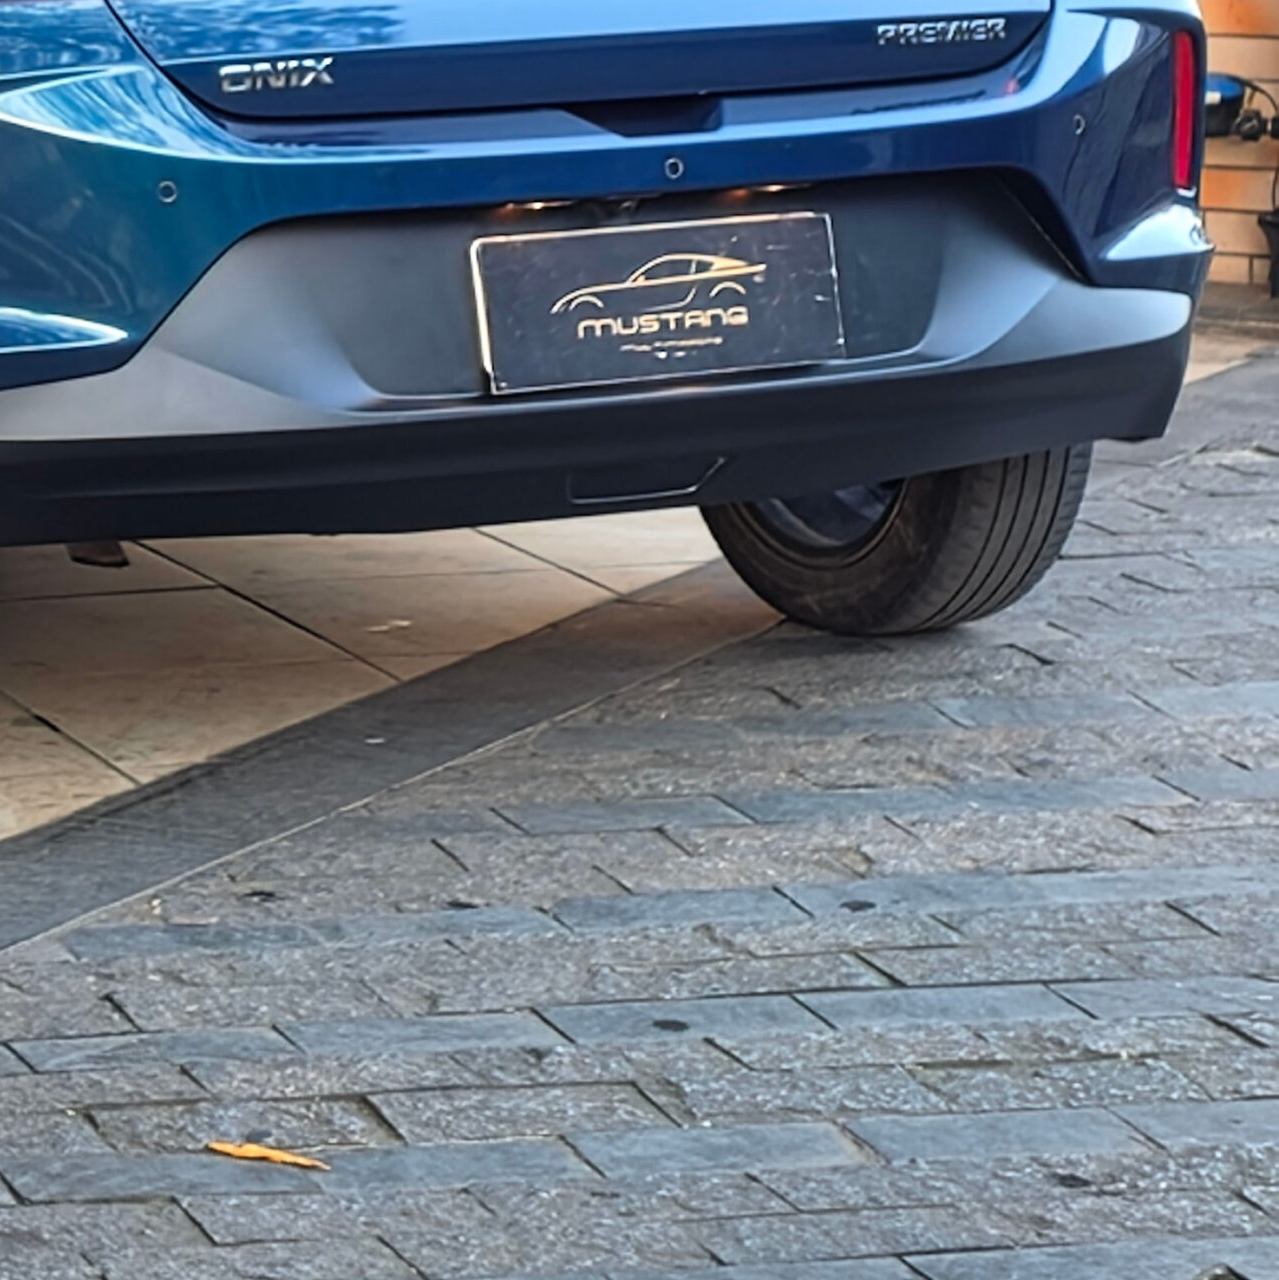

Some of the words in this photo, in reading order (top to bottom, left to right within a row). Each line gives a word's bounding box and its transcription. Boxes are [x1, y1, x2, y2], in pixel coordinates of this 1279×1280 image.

[877, 17, 1006, 45] PREMIER
[219, 56, 334, 92] ONIX
[577, 305, 750, 338] MUSTANG
